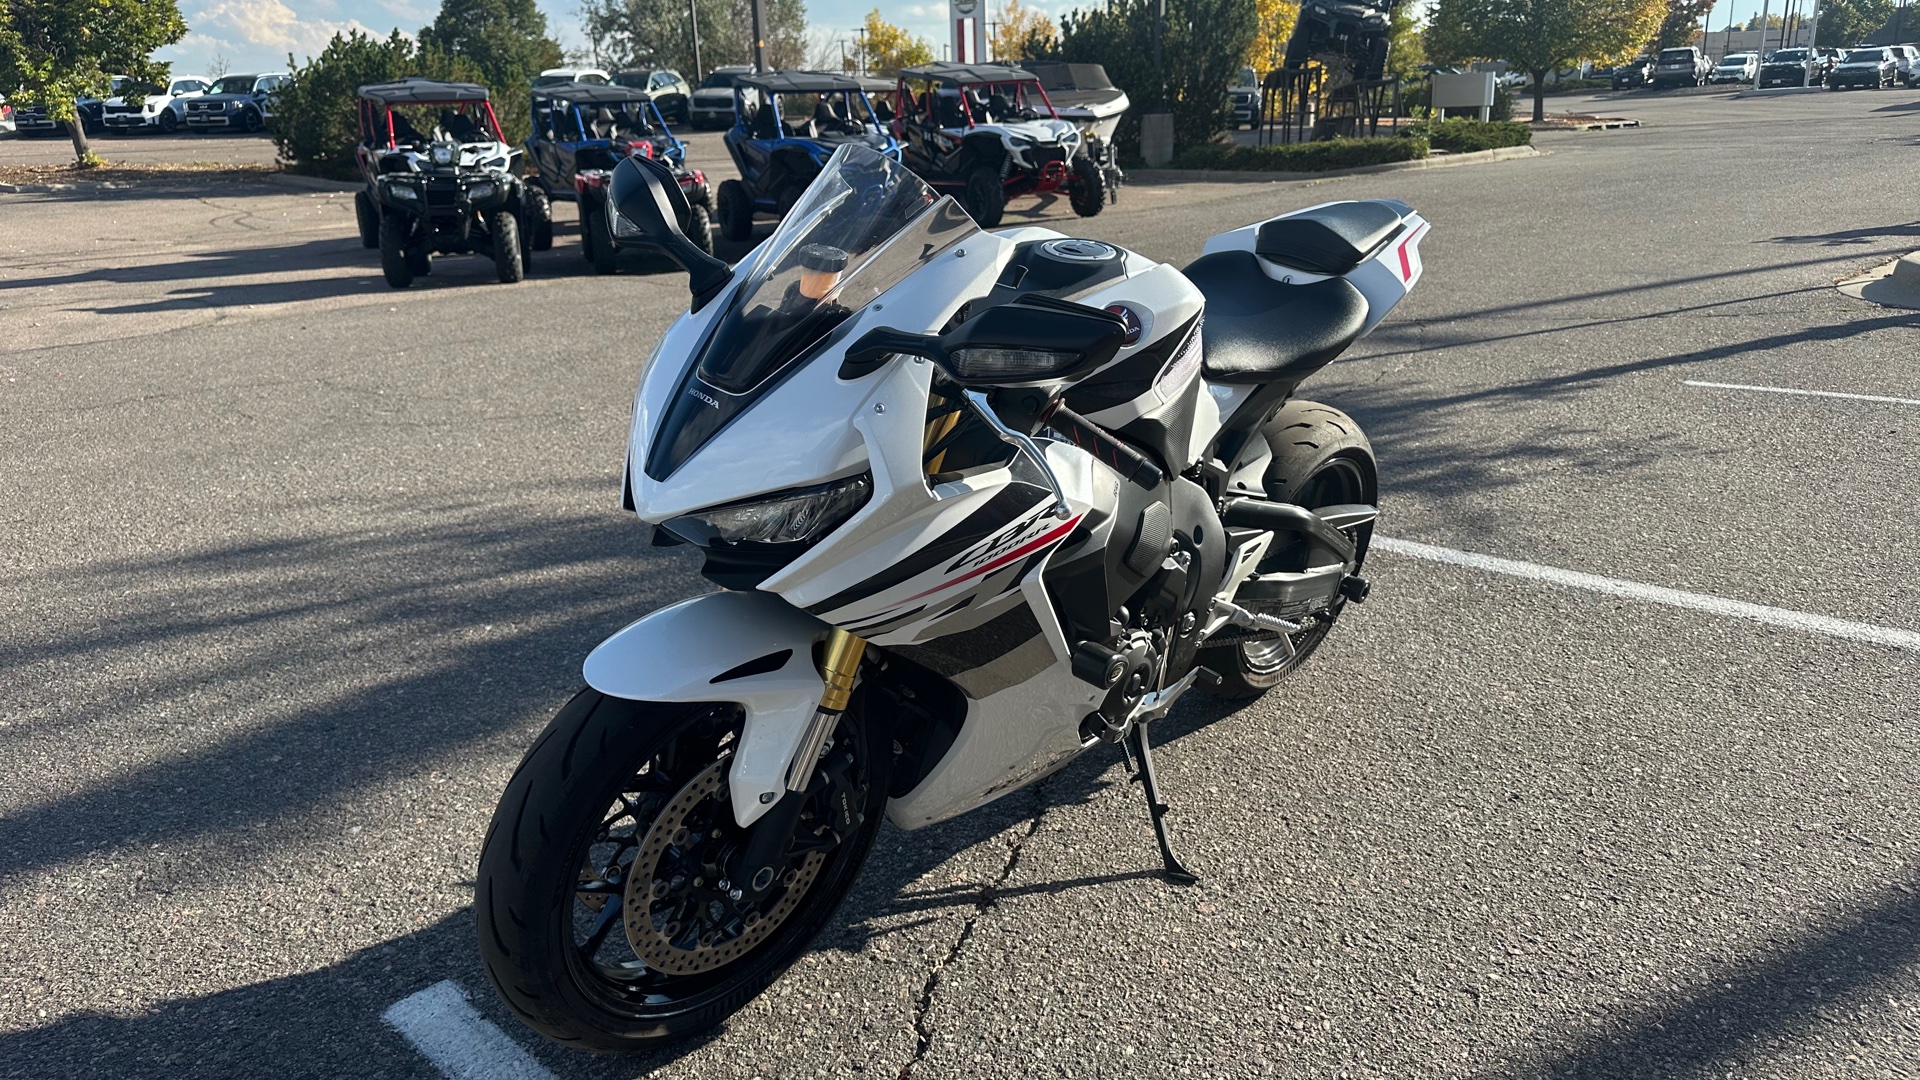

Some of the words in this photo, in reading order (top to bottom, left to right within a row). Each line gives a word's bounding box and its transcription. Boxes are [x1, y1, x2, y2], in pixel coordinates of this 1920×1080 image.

[688, 388, 719, 410] HONDA
[944, 500, 1058, 575] CBR
[972, 523, 1051, 568] 1000RR
[841, 791, 850, 825] TOKICO
